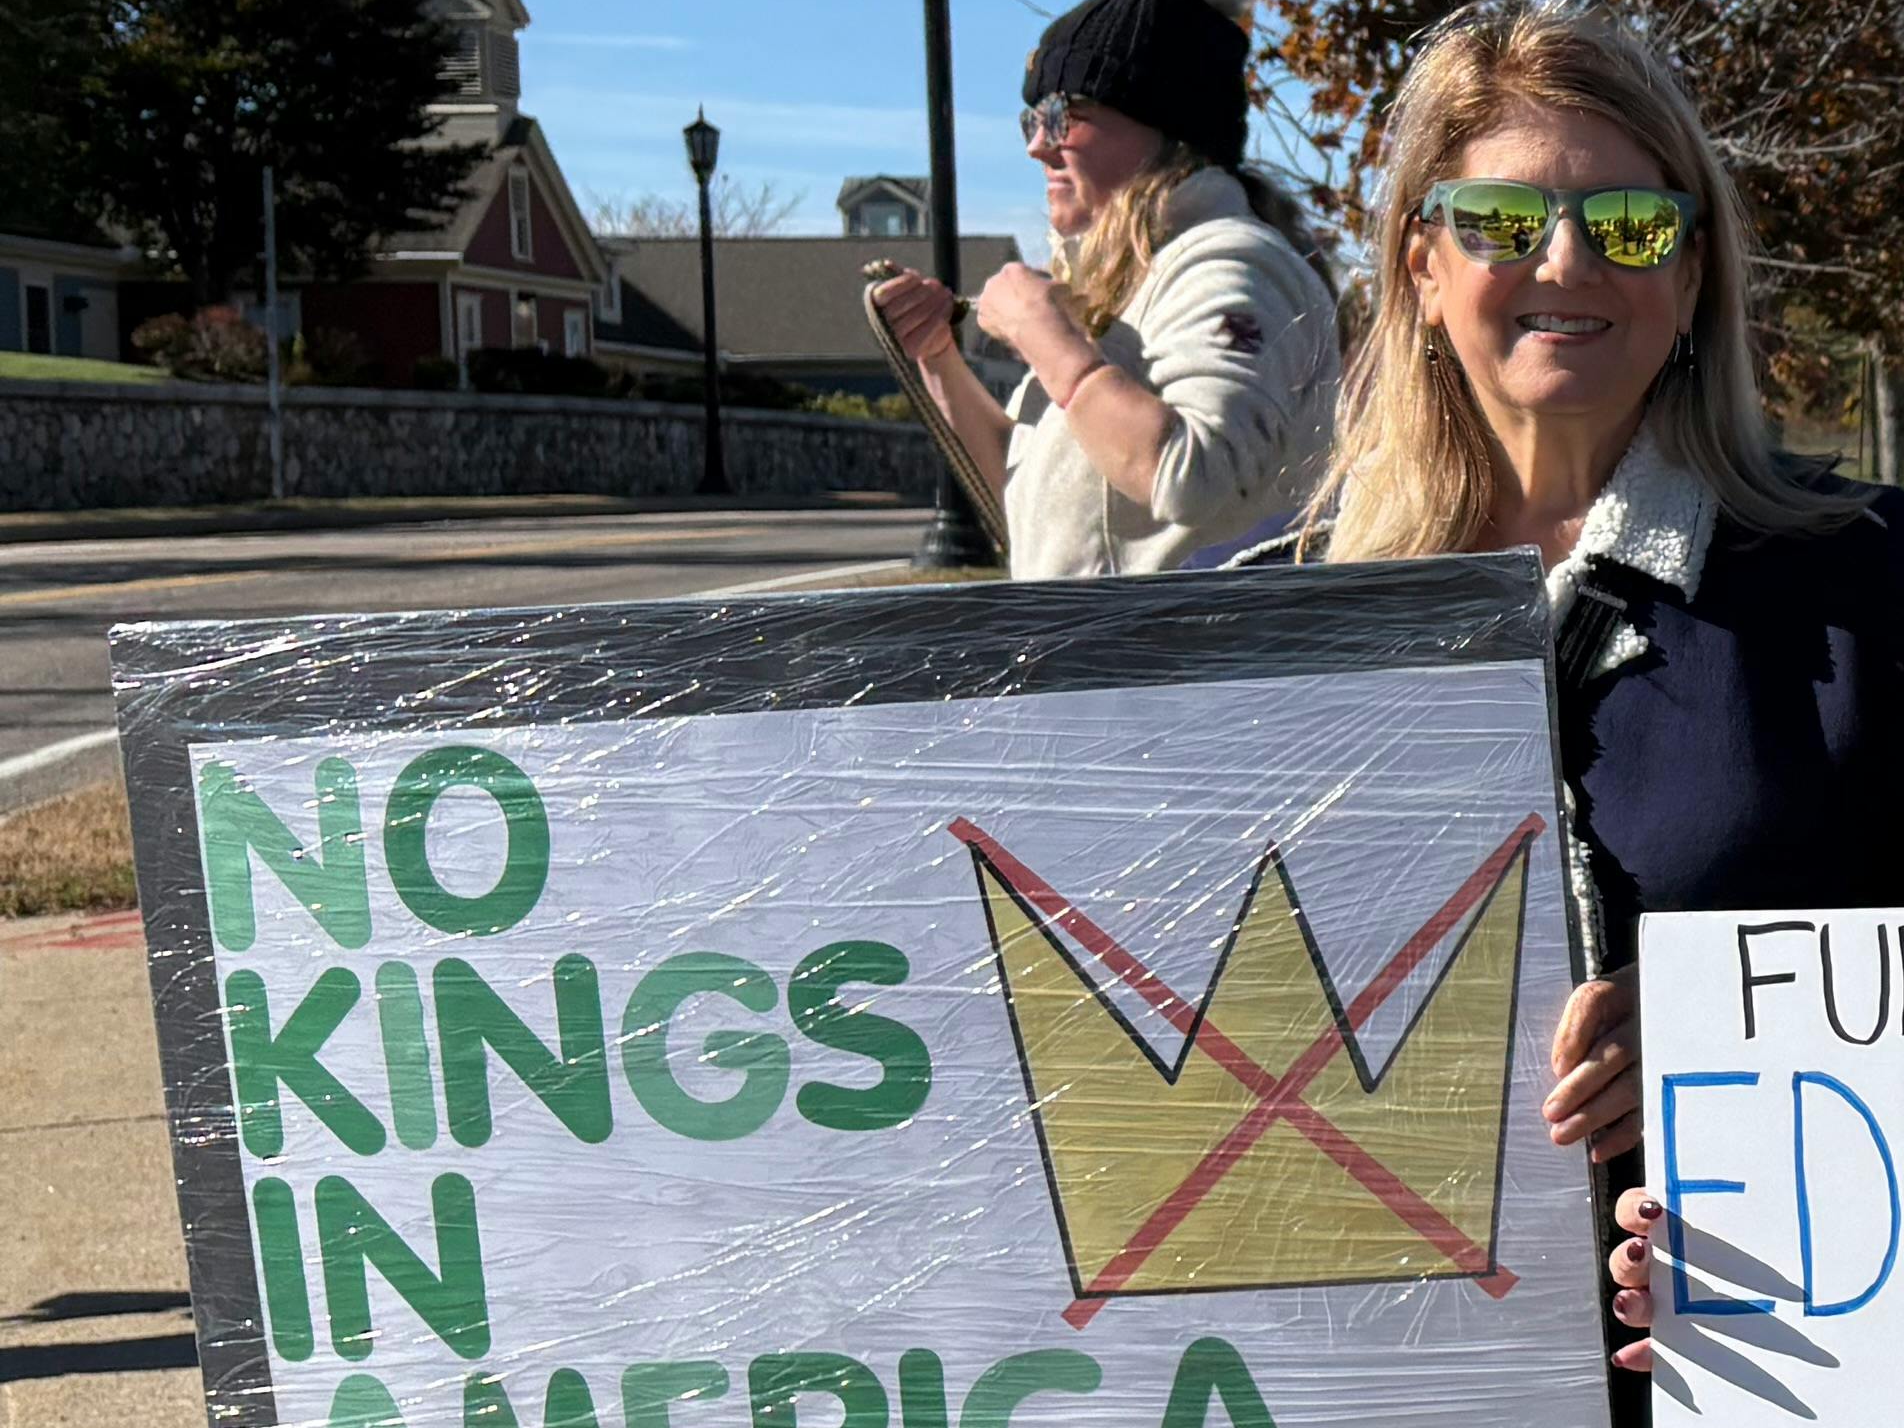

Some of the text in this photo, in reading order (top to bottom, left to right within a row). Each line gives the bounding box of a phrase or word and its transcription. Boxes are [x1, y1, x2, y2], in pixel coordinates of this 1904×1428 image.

[200, 745, 550, 951] NO
[226, 941, 932, 1156] KINGS
[251, 1172, 490, 1362] IN
